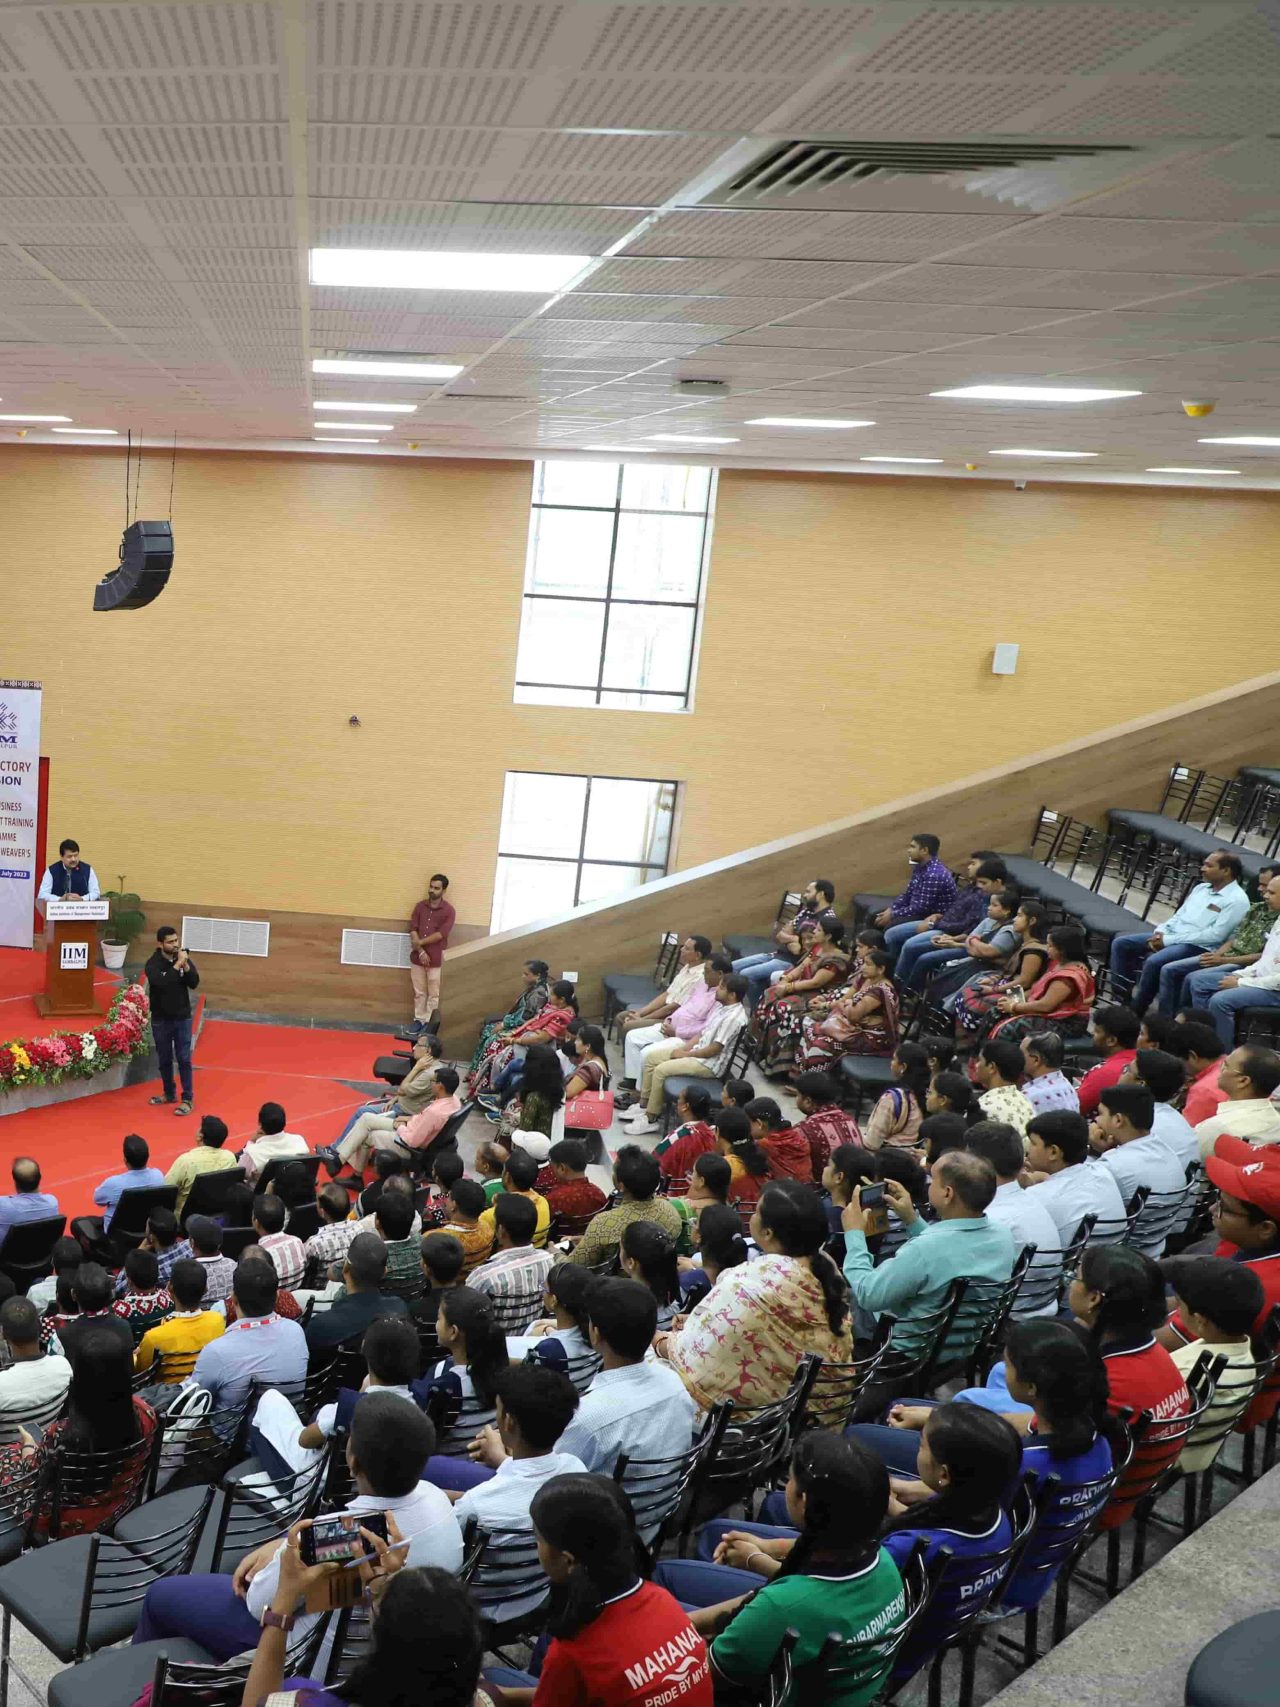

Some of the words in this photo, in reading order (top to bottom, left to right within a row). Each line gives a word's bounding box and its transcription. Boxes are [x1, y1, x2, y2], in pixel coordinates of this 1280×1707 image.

[4, 817, 34, 828] TRAINING
[1, 847, 31, 858] WEAVER'S
[63, 947, 86, 959] IIM
[624, 1622, 702, 1690] MAHANA
[645, 1686, 679, 1707] PRIDE
[678, 1676, 692, 1694] BY
[691, 1666, 704, 1685] MY
